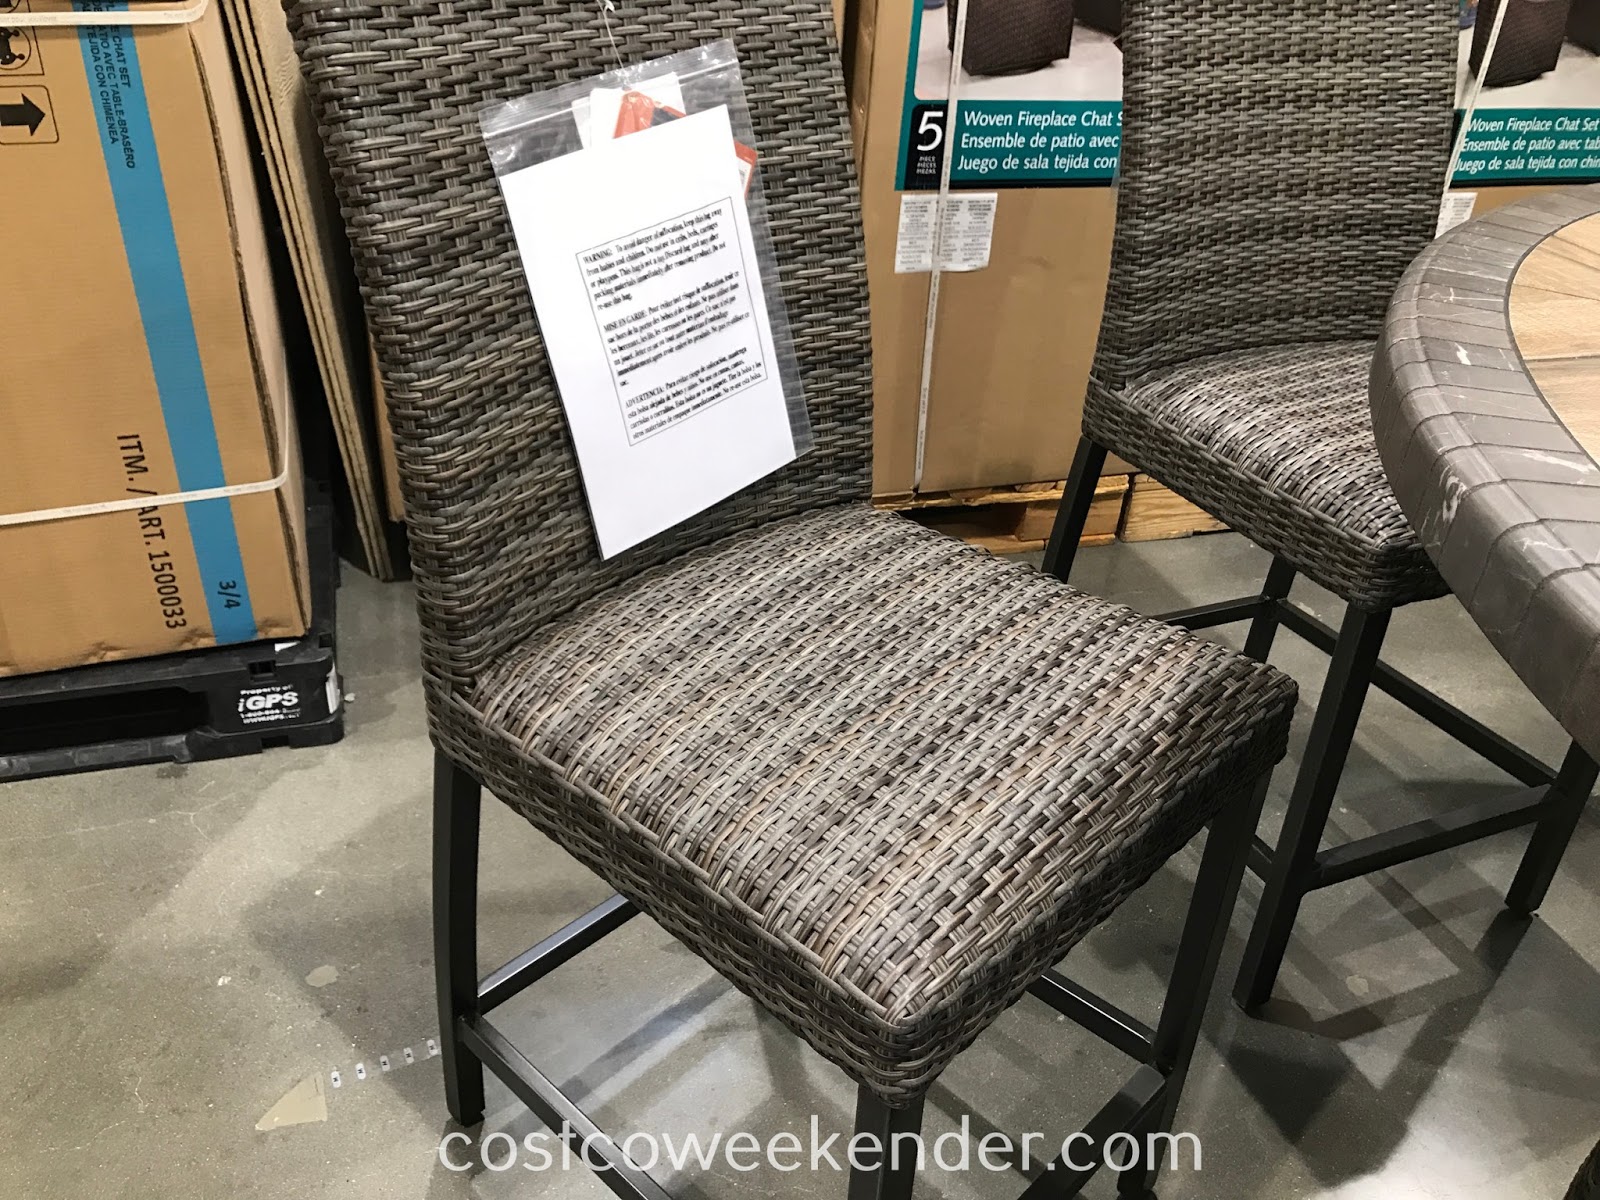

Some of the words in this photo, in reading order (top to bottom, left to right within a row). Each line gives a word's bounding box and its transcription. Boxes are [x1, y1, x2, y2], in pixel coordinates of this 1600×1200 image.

[97, 26, 110, 49] ATIO
[112, 36, 127, 65] CHAT
[94, 64, 107, 88] CON
[103, 51, 116, 80] AVEC
[119, 66, 131, 88] SET
[100, 90, 119, 144] CHIMENEA
[964, 110, 1013, 127] Woven
[1017, 110, 1077, 130] Fireplace
[1081, 110, 1114, 127] Chat
[1469, 118, 1504, 132] Woven
[1506, 116, 1552, 134] Fireplace
[1554, 116, 1581, 131] Chat
[1582, 117, 1600, 132] Set
[917, 110, 944, 151] 5
[961, 132, 1025, 149] Ensemble
[1030, 132, 1047, 149] de
[1050, 133, 1085, 152] patio
[1089, 135, 1120, 149] avec
[1461, 136, 1511, 152] Ensemble
[1512, 136, 1527, 150] de
[1527, 137, 1556, 153] patio
[1557, 139, 1582, 151] avec
[957, 155, 998, 174] Juego
[1002, 153, 1019, 170] de
[1023, 153, 1050, 170] sala
[1054, 153, 1090, 174] tejida
[1093, 156, 1118, 169] con
[1453, 157, 1486, 175] Juego
[1488, 156, 1503, 170] de
[1504, 155, 1525, 170] sala
[1528, 155, 1556, 173] tejida
[1558, 157, 1579, 169] con
[117, 433, 149, 483] ITM.
[148, 550, 188, 629] 1500033
[218, 579, 242, 610] 3/4
[238, 691, 299, 713] iGPS
